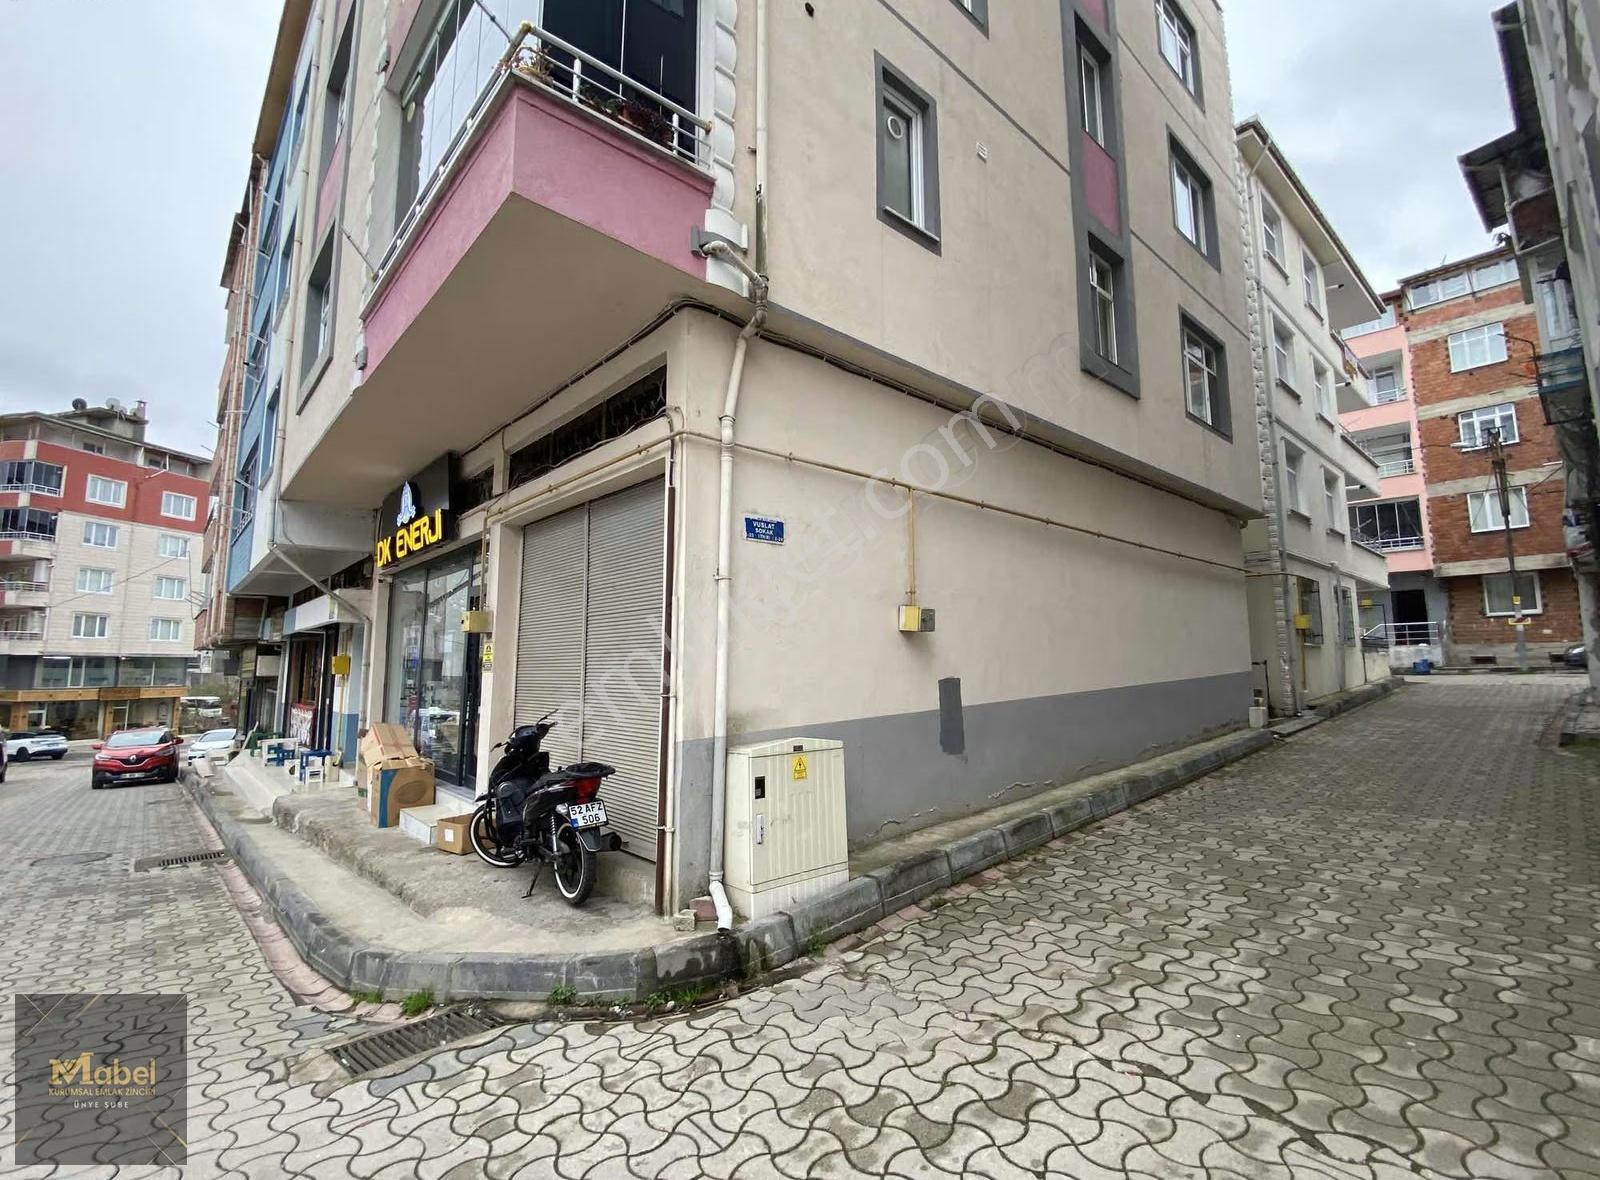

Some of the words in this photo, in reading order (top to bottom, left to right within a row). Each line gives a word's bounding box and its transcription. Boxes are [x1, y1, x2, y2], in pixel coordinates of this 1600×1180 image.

[753, 521, 775, 530] VUSLAT
[755, 527, 774, 536] SOKAK
[377, 536, 391, 568] DK
[570, 805, 584, 815] 52
[585, 802, 603, 813] AFZ
[582, 813, 600, 824] 506
